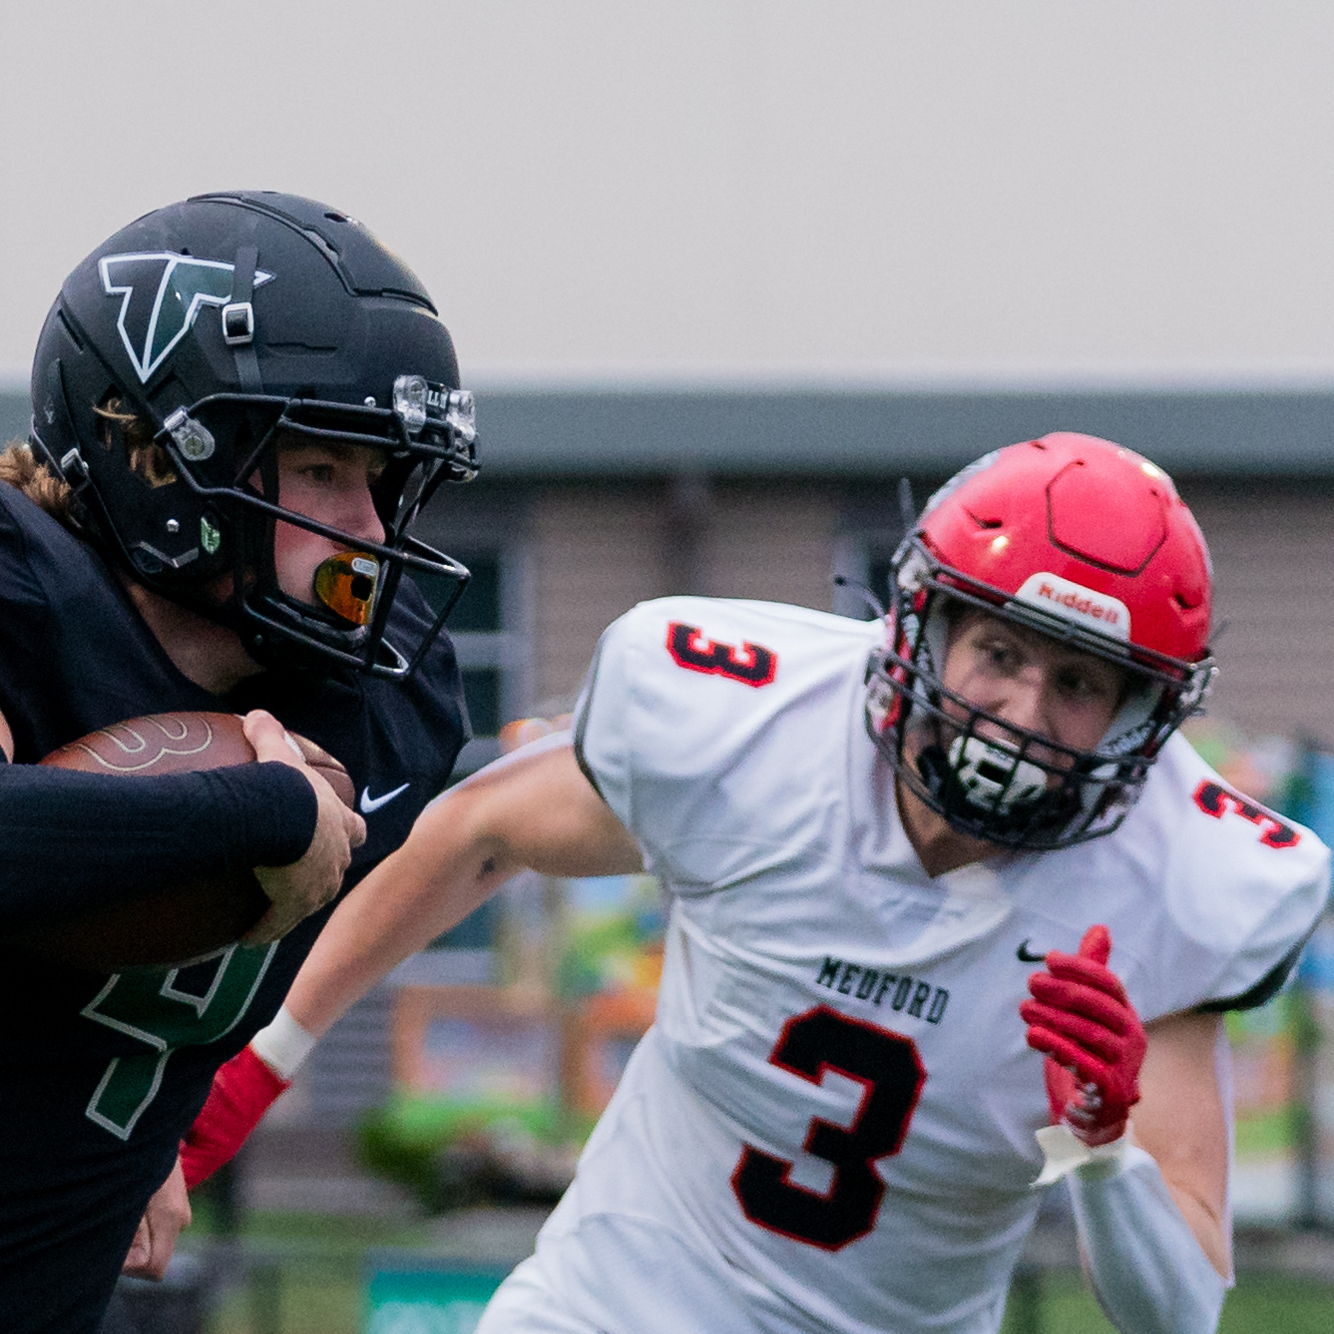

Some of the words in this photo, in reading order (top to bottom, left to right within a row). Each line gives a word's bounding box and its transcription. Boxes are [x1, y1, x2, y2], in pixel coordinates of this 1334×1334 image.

[1038, 583, 1119, 623] Riddell
[666, 620, 778, 688] 3
[816, 956, 950, 1024] MEDFORD
[730, 1002, 928, 1254] 3
